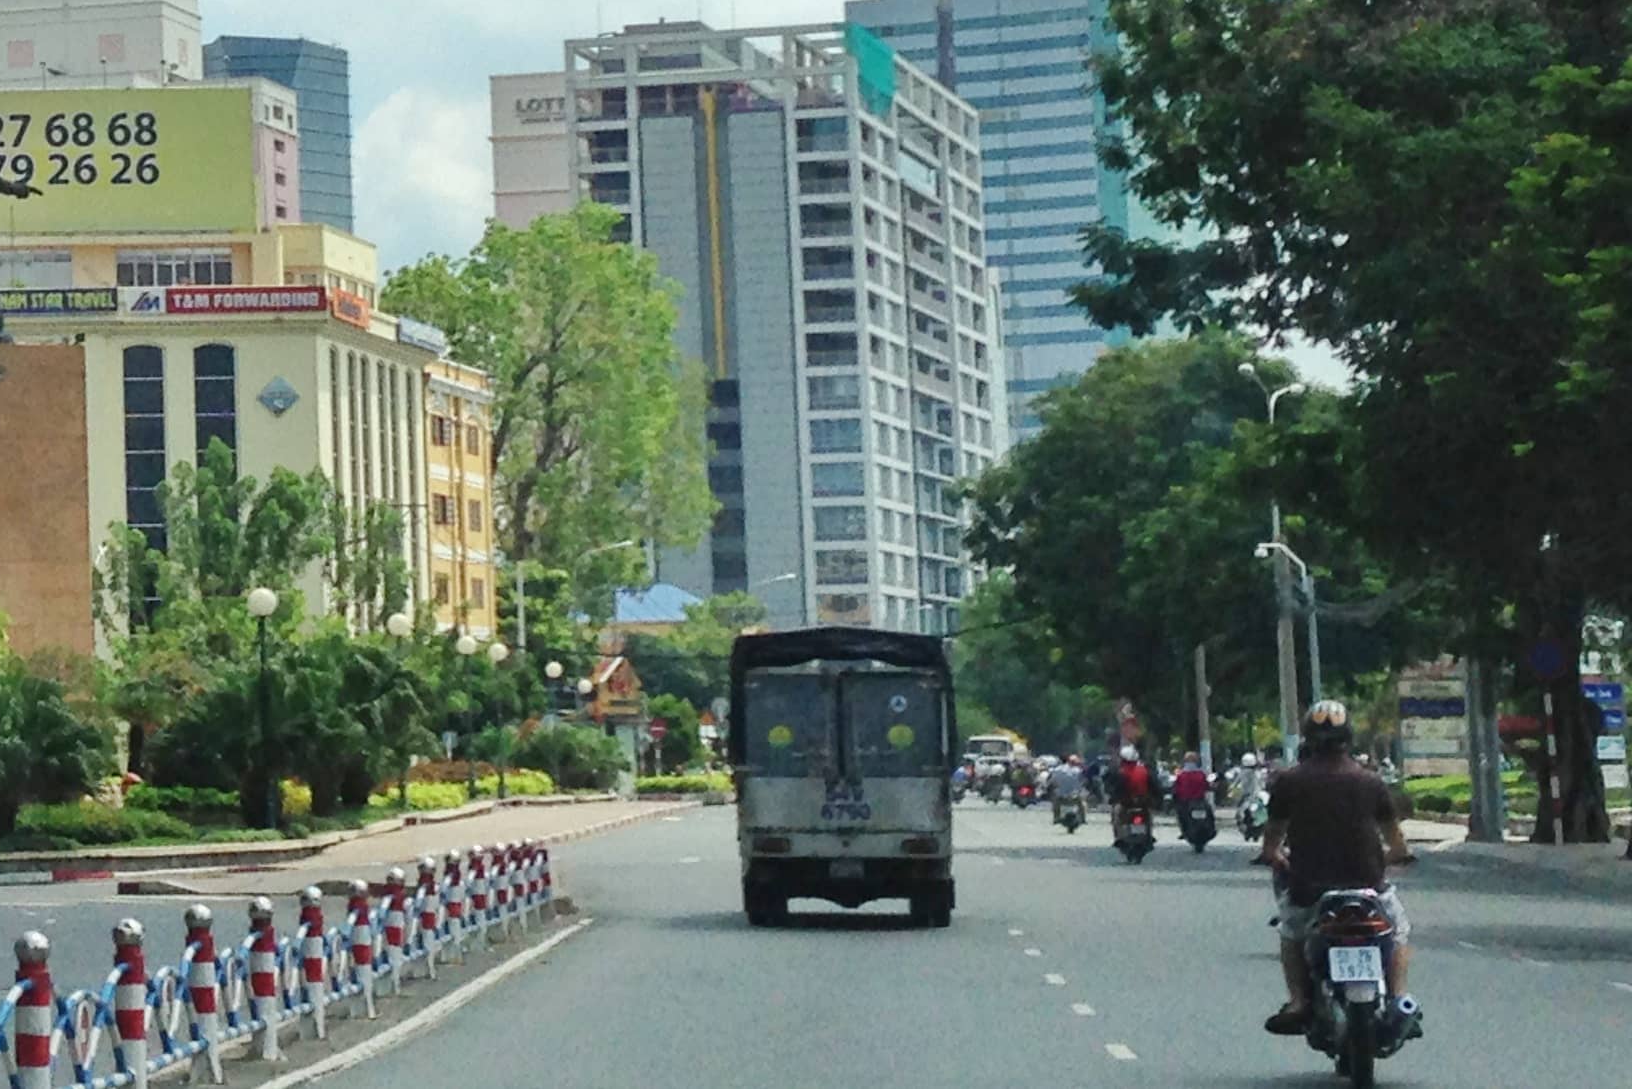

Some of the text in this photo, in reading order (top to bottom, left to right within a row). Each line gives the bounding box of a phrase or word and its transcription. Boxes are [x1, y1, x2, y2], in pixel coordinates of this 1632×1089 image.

[45, 112, 95, 147] 68
[107, 112, 158, 146] 68
[48, 153, 97, 185] 26
[110, 153, 159, 185] 26
[31, 293, 63, 310] STAR
[68, 291, 115, 309] TRAVEL
[171, 293, 210, 309] T&M
[213, 291, 320, 308] FORWARDING
